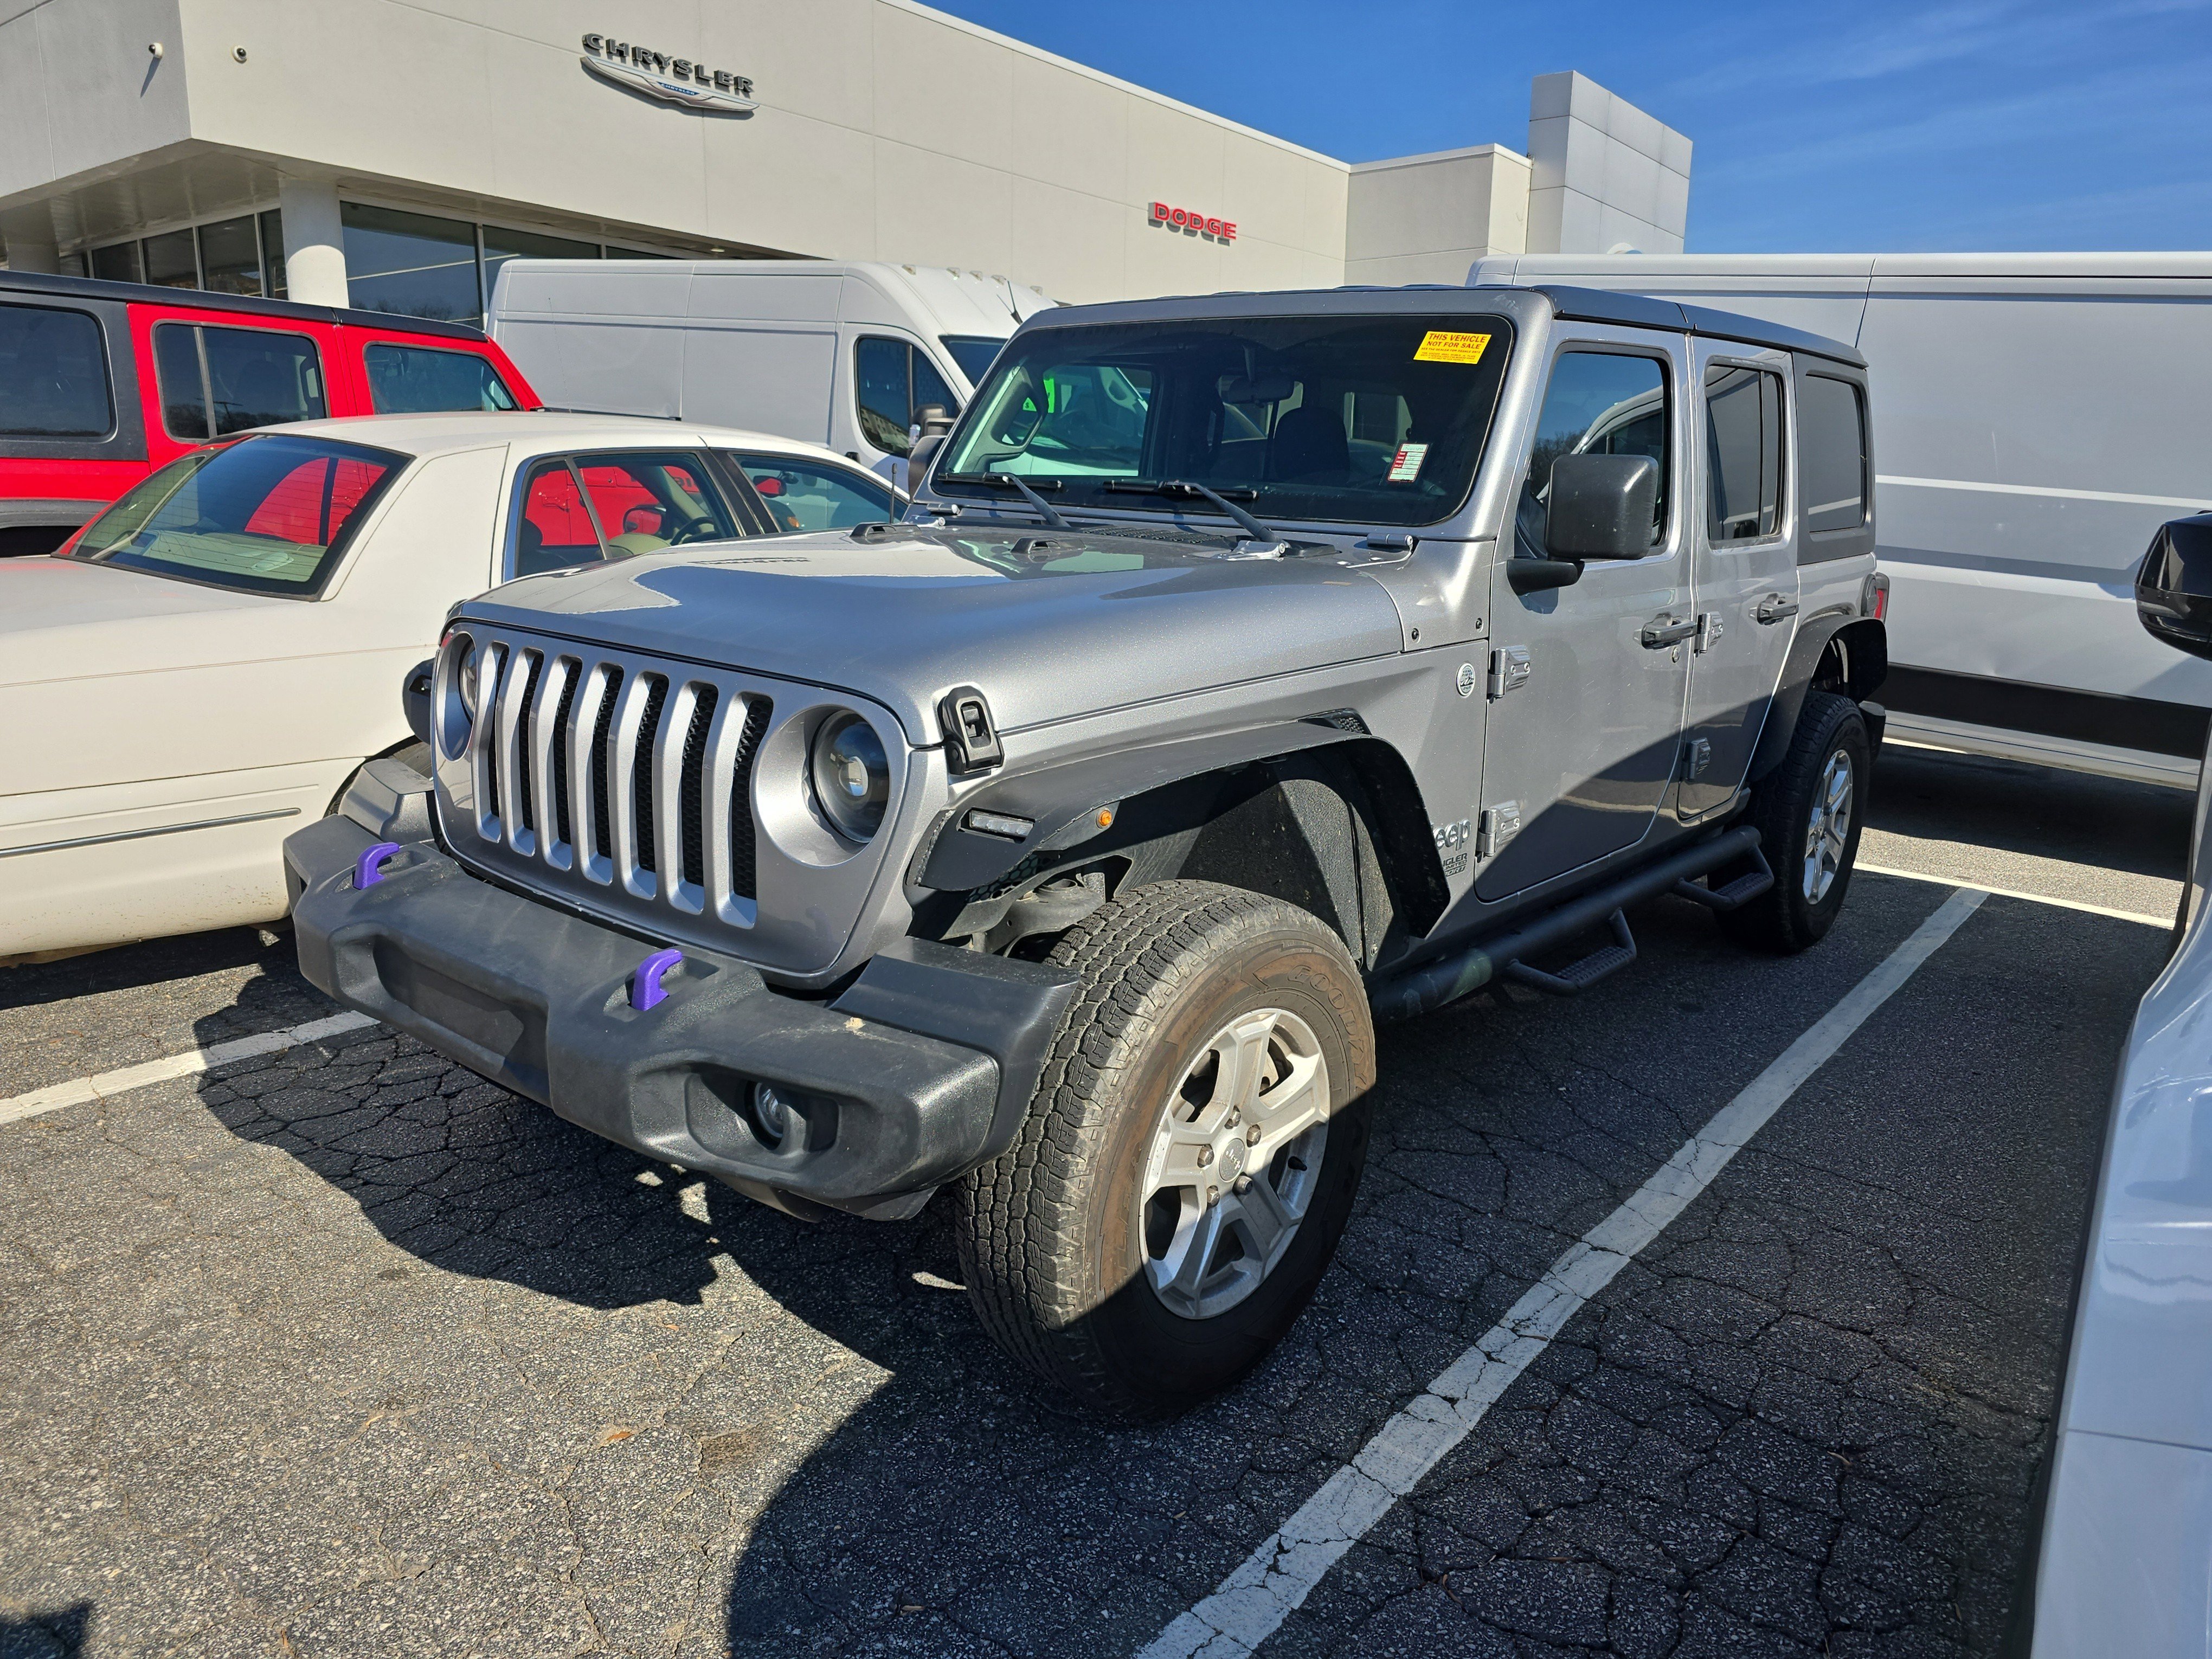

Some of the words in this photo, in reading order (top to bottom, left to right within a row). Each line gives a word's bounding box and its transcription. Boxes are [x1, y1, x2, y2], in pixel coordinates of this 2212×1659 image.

[582, 33, 754, 93] CHRYSLER
[1154, 202, 1236, 240] DODGE
[1450, 334, 1487, 343] VEHICLE
[1443, 852, 1468, 867] GLER
[1444, 859, 1467, 870] IMITED
[1444, 865, 1466, 877] ORT
